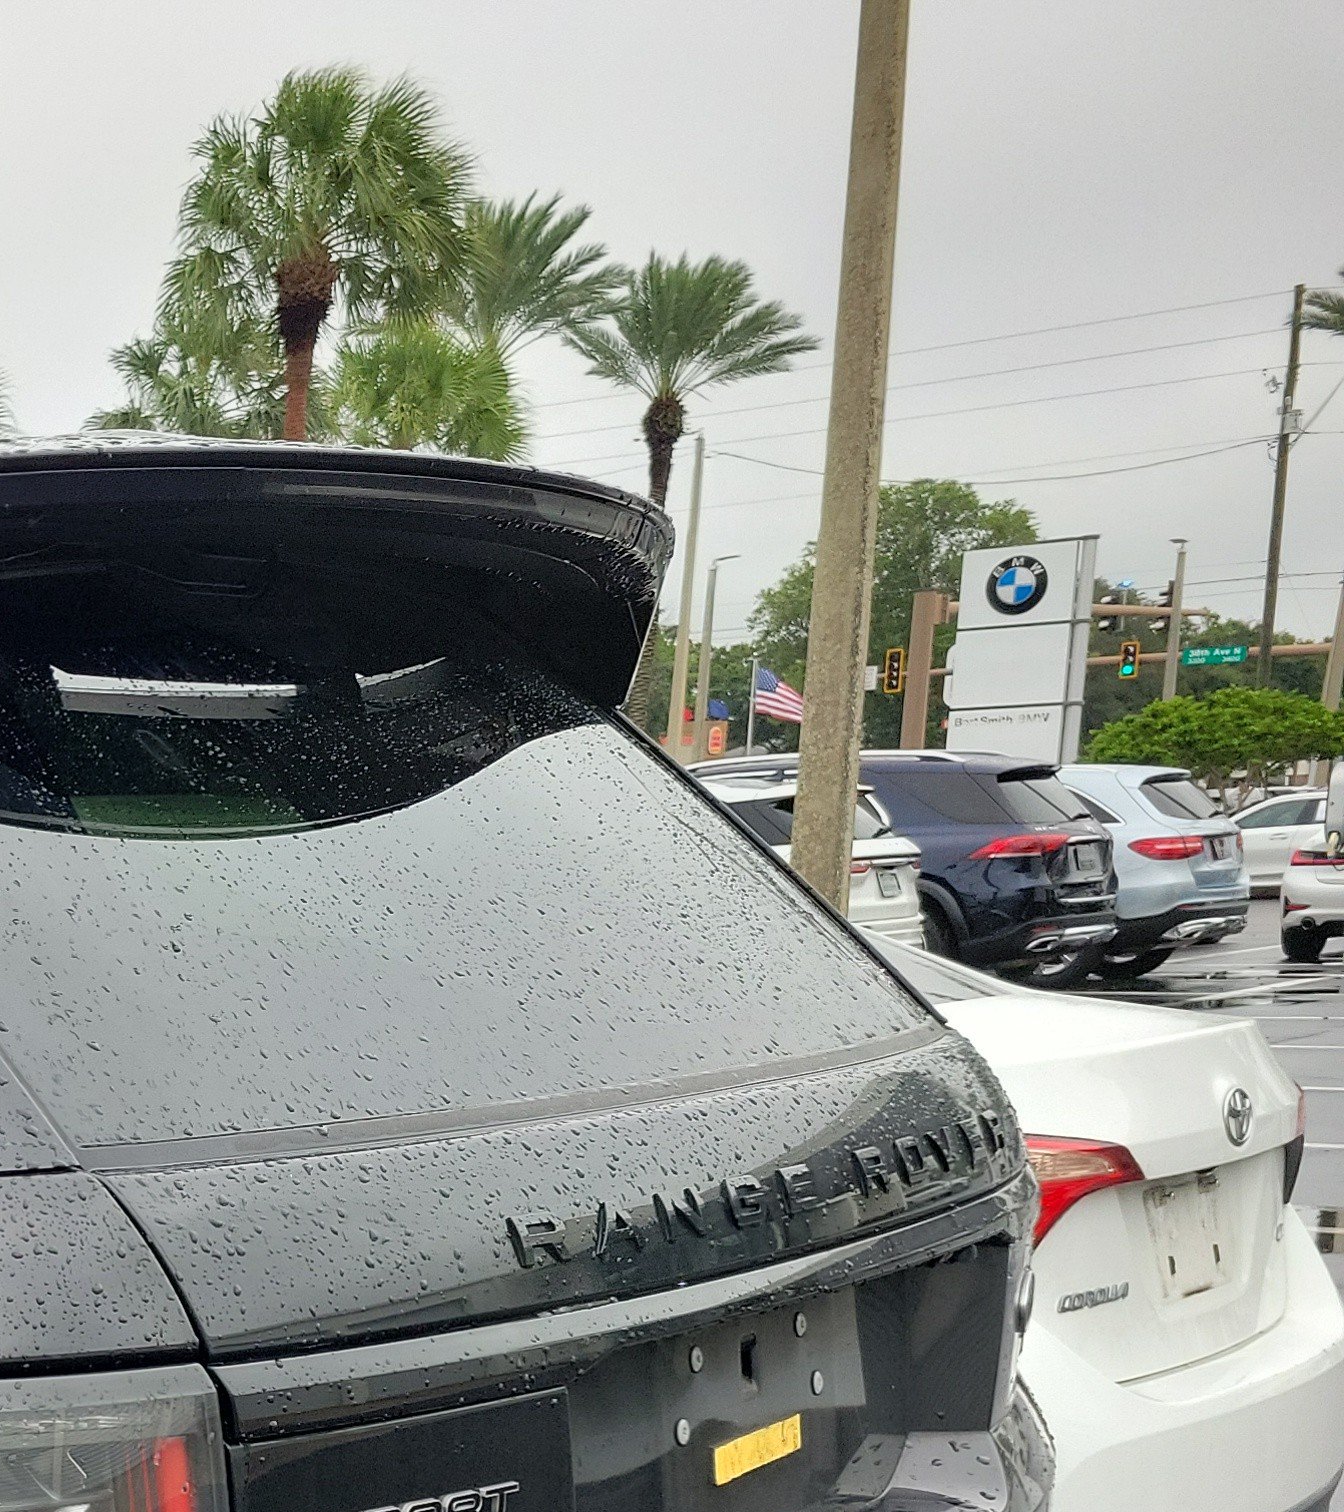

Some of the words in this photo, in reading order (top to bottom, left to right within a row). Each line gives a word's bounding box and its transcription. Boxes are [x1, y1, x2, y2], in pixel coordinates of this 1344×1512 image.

[993, 557, 1044, 578] BMW
[1213, 647, 1231, 656] Ave
[980, 715, 1013, 725] Smith
[1017, 711, 1050, 723] BMW
[504, 1163, 820, 1269] RANGE
[851, 1108, 1006, 1199] ROVER
[1056, 1281, 1129, 1314] COROLLA
